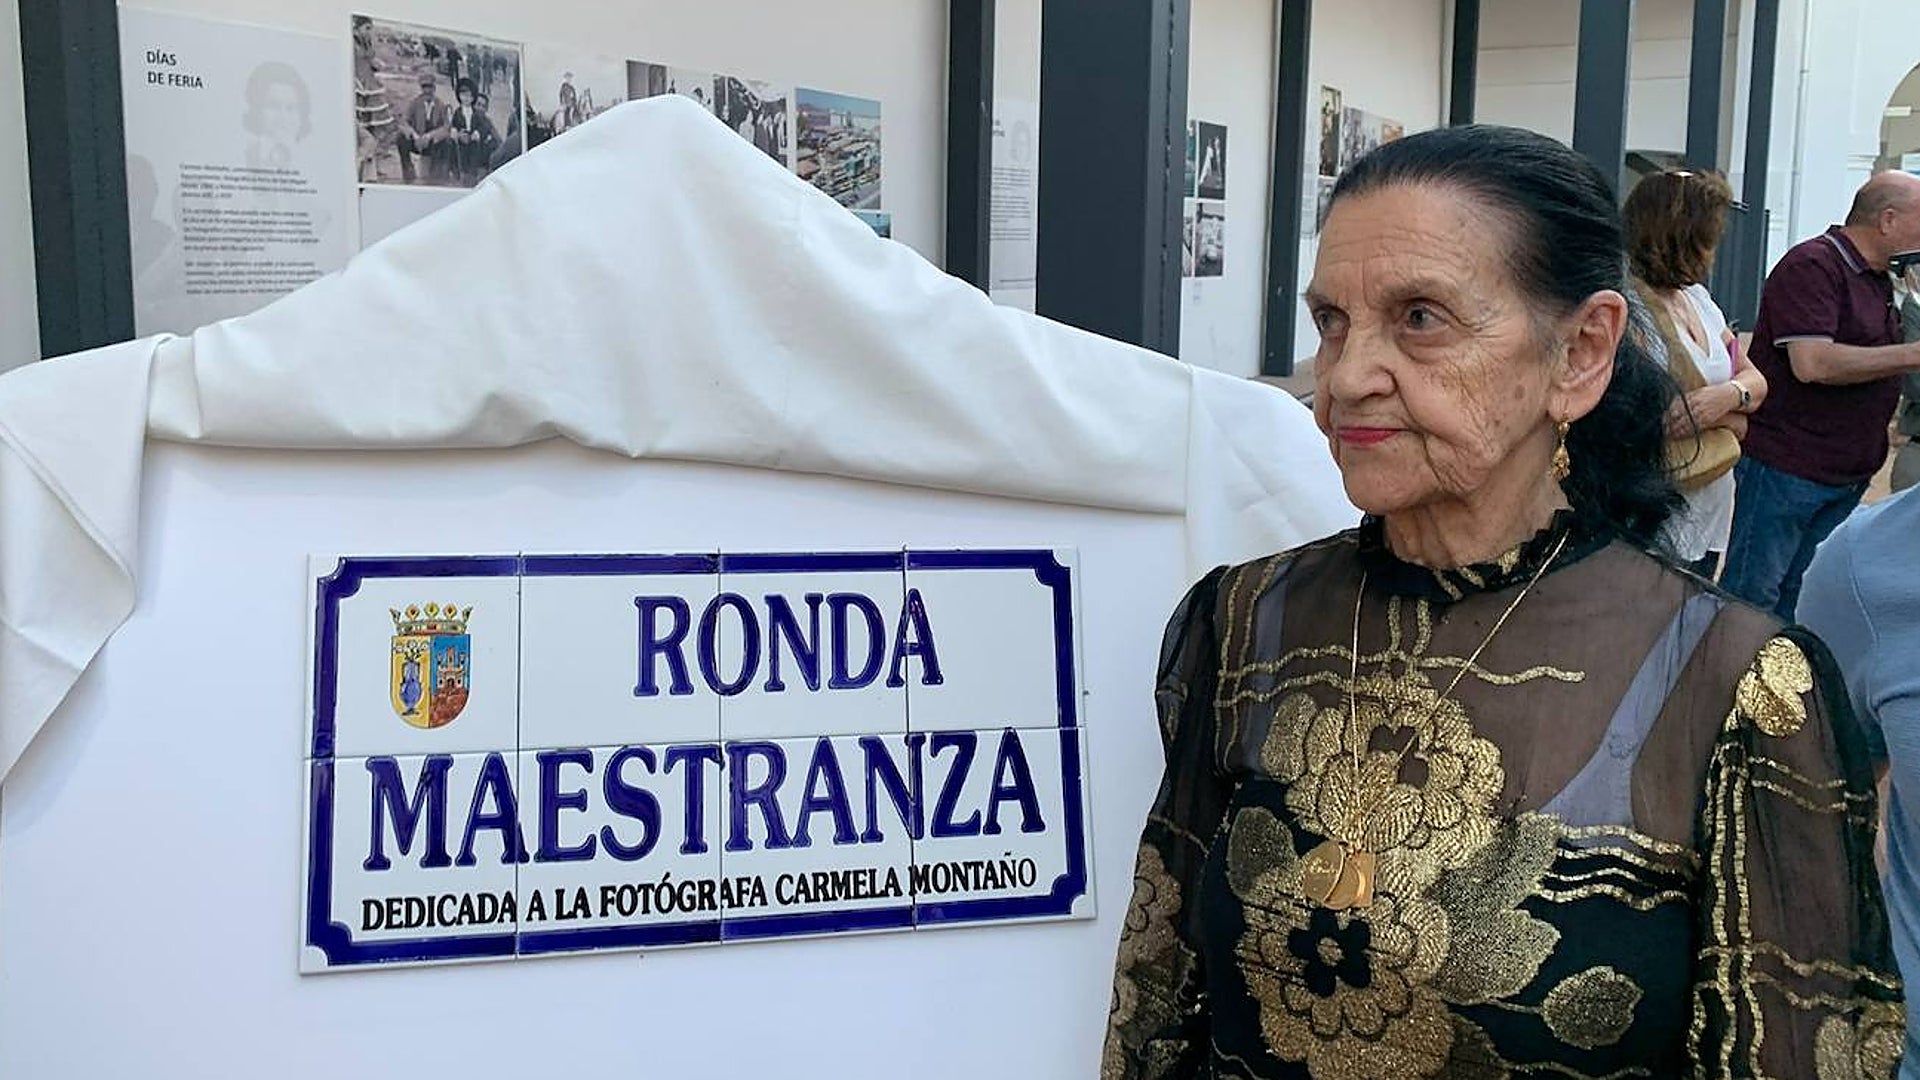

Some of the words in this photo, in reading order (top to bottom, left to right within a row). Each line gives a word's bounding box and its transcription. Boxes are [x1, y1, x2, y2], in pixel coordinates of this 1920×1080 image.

[146, 48, 177, 66] DÍAS
[147, 71, 165, 85] DE
[168, 73, 203, 89] FERIA
[633, 588, 944, 696] RONDA
[363, 727, 1046, 871] MAESTRANZA
[362, 891, 517, 931] DEDICADA
[526, 889, 548, 922] A
[554, 887, 594, 920] LA
[599, 872, 768, 918] FOTÓGRAFA
[775, 867, 900, 906] CARMELA
[908, 852, 1037, 896] MONTAÑO
